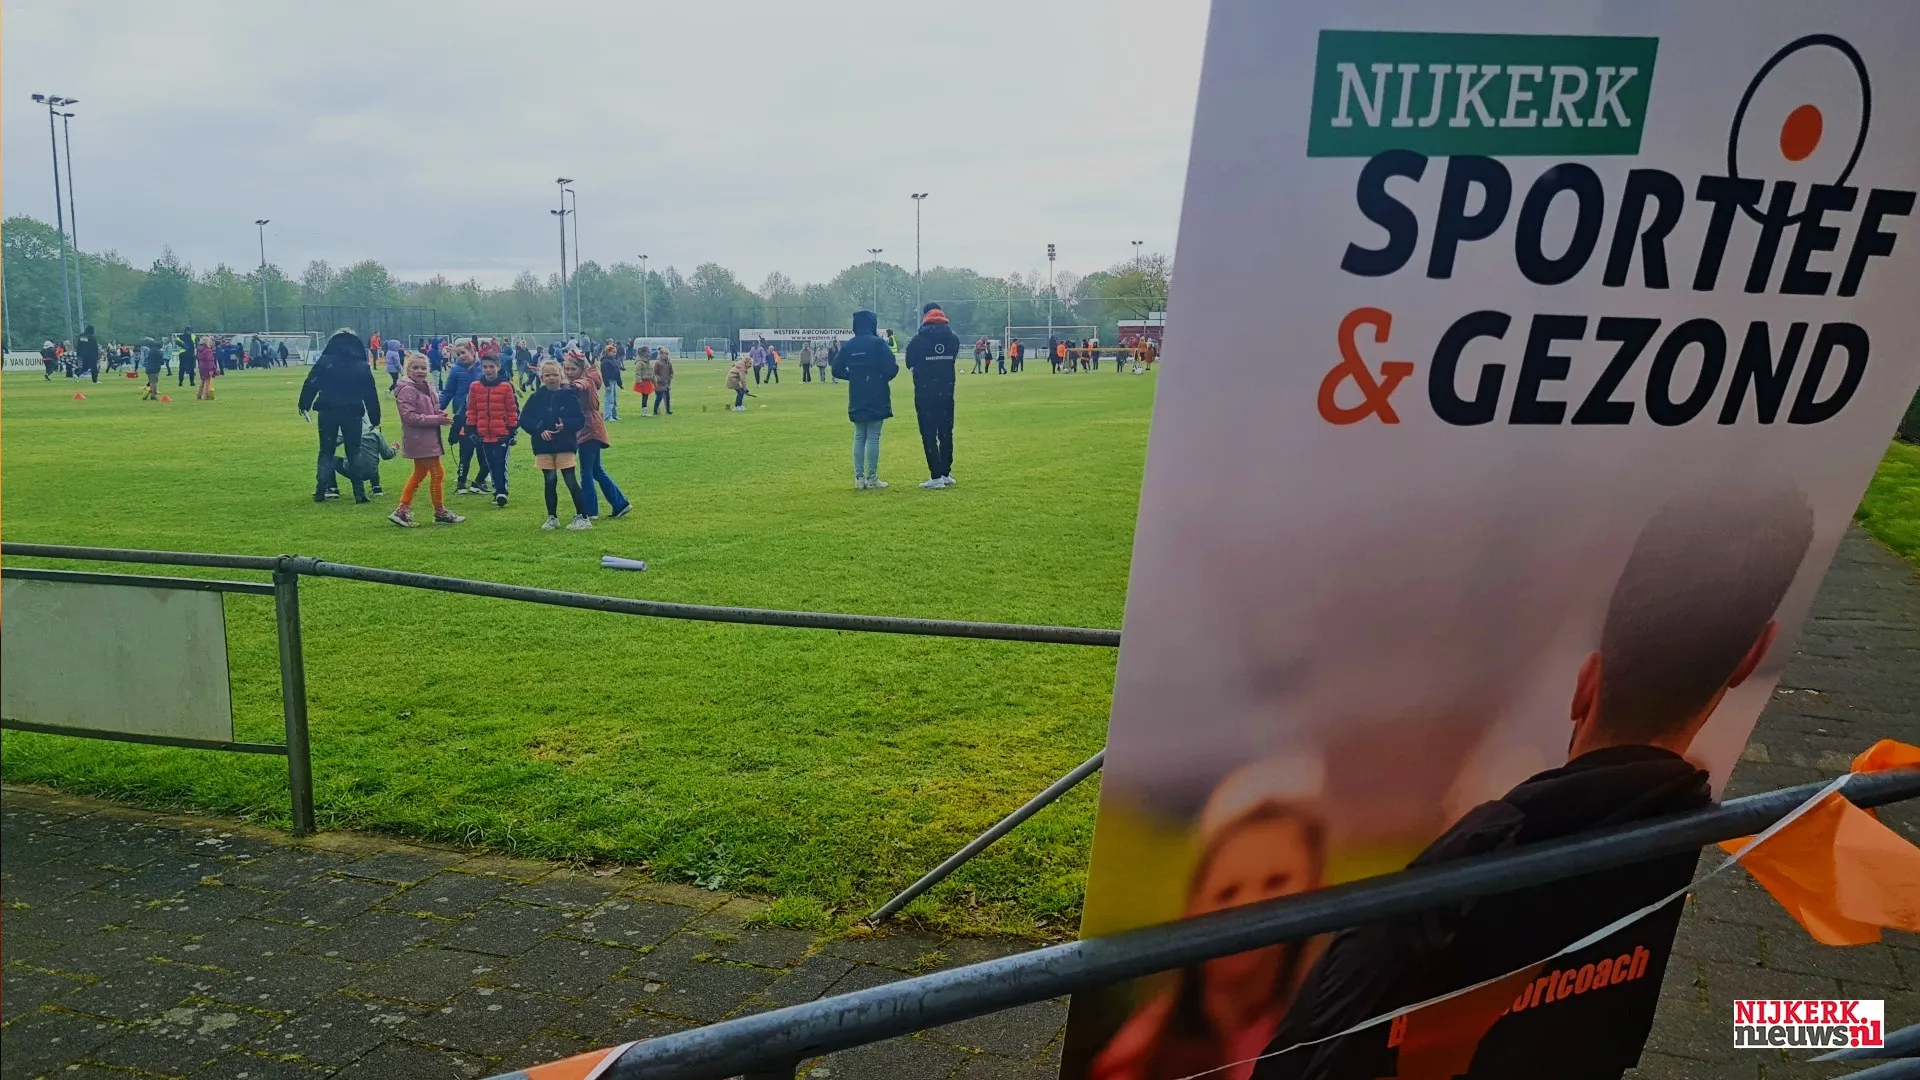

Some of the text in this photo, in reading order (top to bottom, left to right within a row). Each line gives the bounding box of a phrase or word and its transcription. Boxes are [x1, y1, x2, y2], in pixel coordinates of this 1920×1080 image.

[1331, 63, 1639, 129] NIJKERK
[1340, 149, 1917, 297] SPORTIEF
[10, 358, 24, 366] VAN
[1317, 307, 1870, 427] & GEZOND
